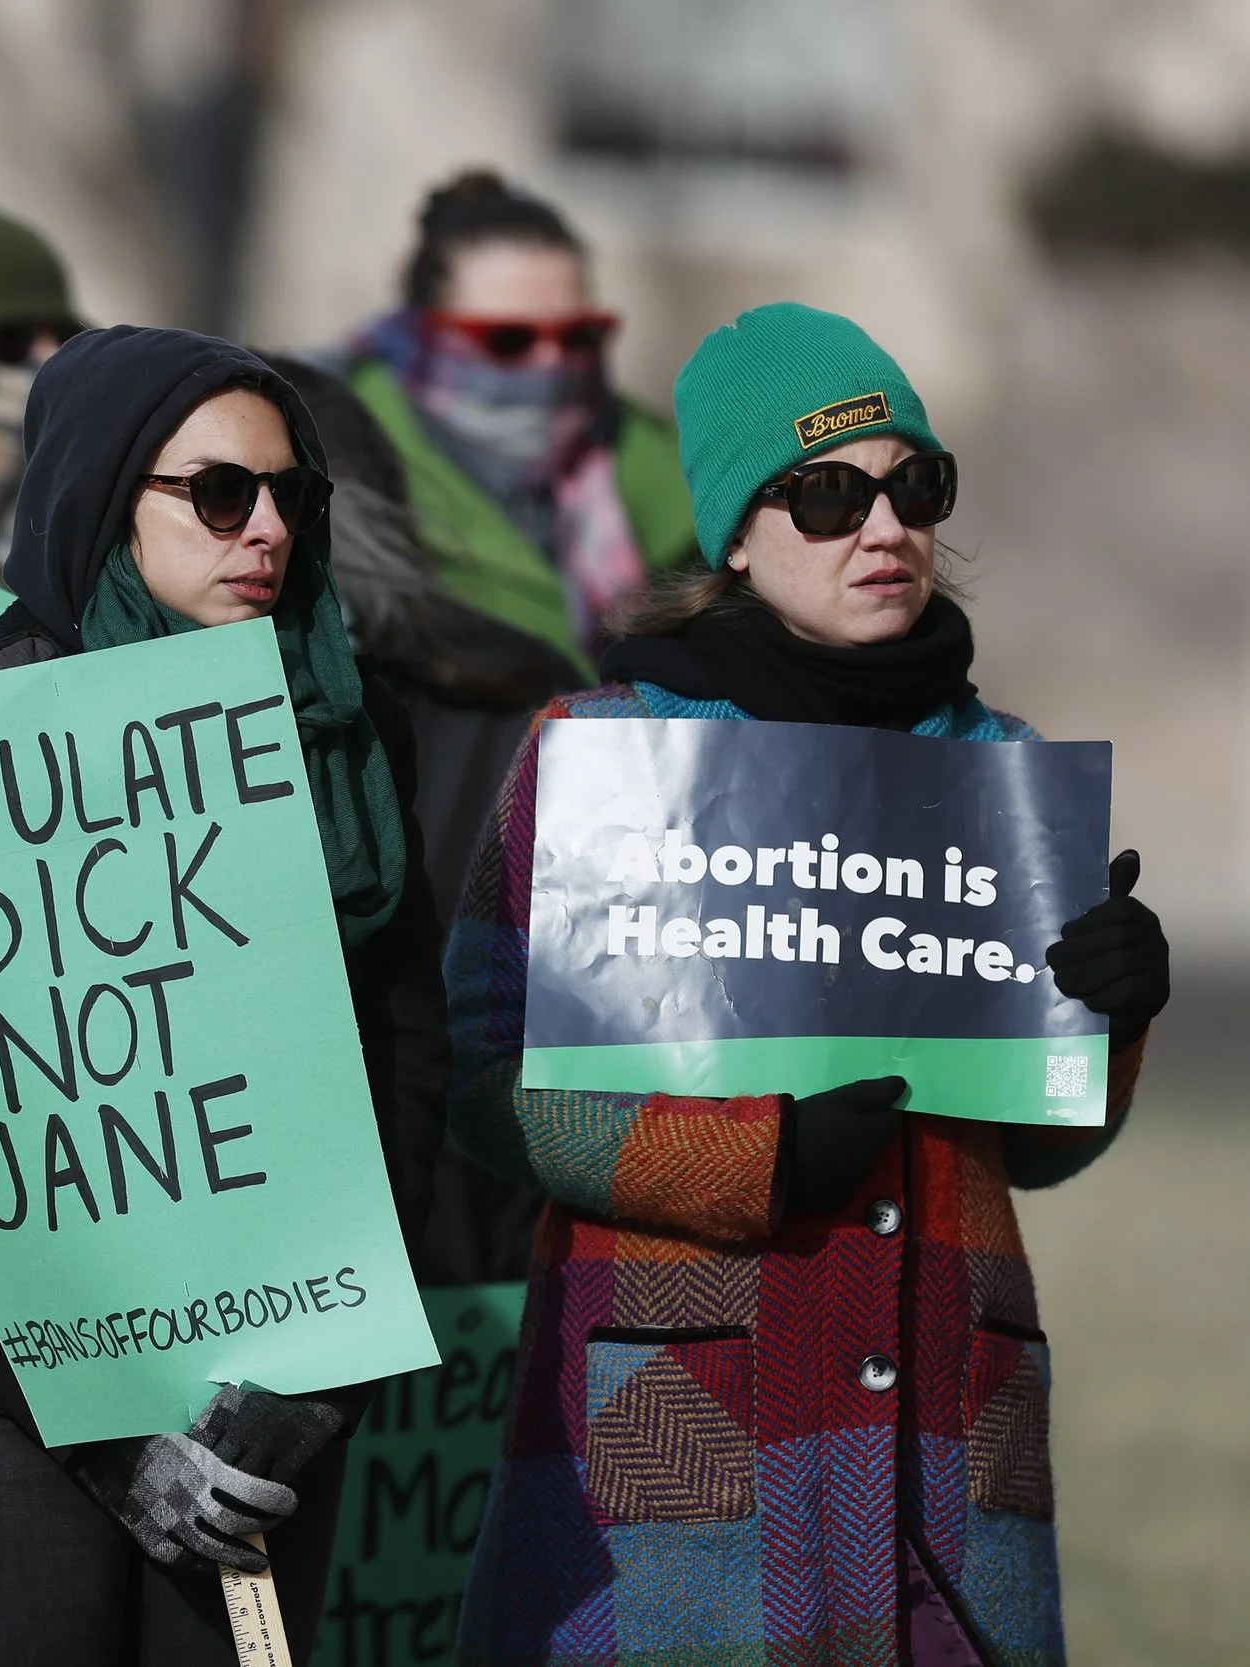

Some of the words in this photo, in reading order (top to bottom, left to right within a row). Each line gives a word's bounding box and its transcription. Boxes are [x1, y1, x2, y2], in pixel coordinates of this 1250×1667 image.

[805, 405, 881, 437] Bromo
[606, 829, 924, 899] Abortion
[944, 846, 999, 908] is
[607, 904, 841, 965] Health
[861, 917, 1036, 984] Care.
[3, 1267, 367, 1370] #BANSOFFOURBODIES
[231, 1572, 242, 1586] 10
[249, 1582, 266, 1626] covered?
[260, 1628, 270, 1640] all
[264, 1642, 272, 1650] it
